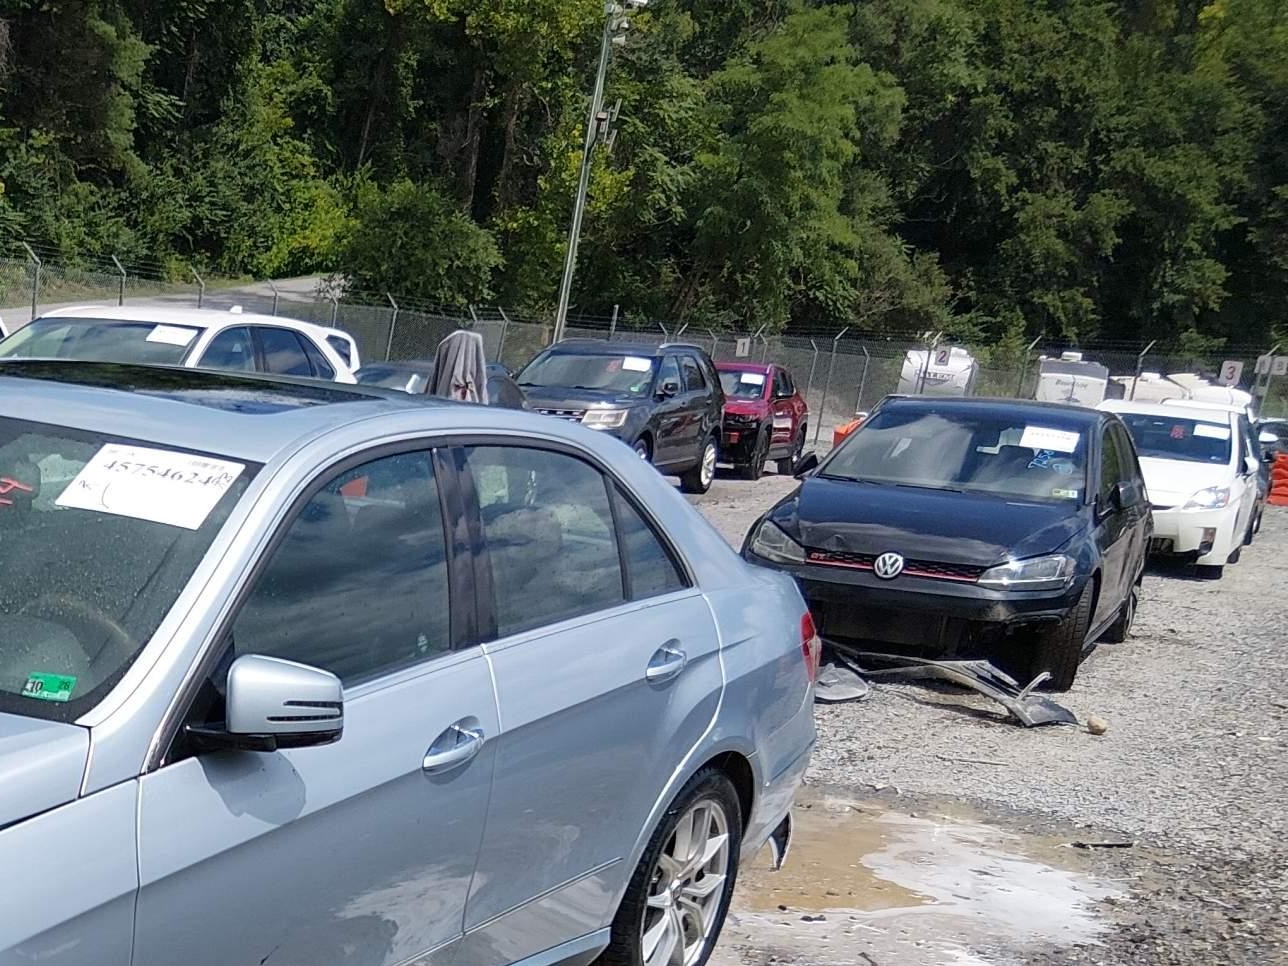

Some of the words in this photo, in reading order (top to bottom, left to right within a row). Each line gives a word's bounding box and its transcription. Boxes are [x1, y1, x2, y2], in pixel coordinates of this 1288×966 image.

[937, 350, 948, 363] 2
[1224, 366, 1236, 380] 3
[103, 459, 214, 486] 45754624
